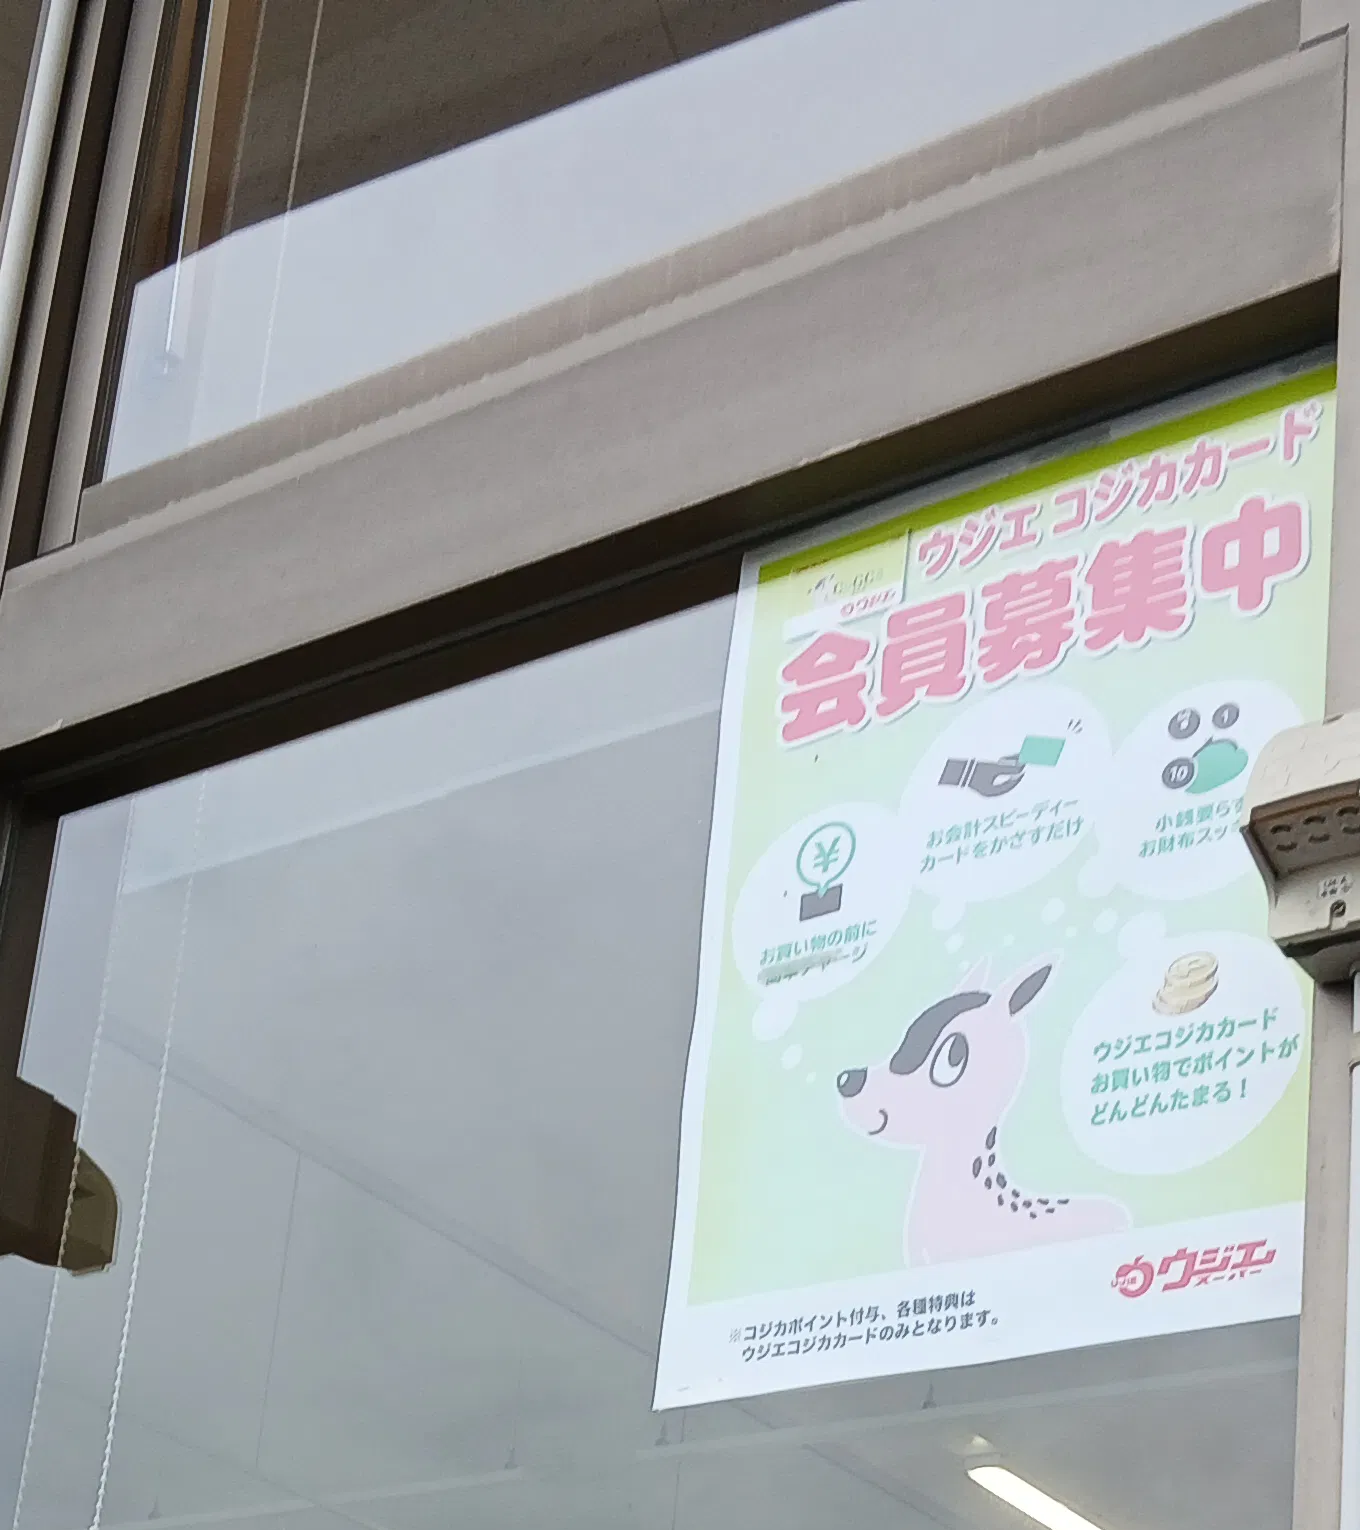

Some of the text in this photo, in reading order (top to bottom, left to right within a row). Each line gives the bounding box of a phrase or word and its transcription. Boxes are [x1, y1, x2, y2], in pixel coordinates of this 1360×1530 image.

[918, 402, 1321, 576] ウジエ コジカカード
[780, 496, 1306, 744] 会員募集中
[919, 815, 1085, 874] カードをかざすだけ
[926, 798, 1079, 849] お会計スピーディー
[760, 919, 877, 966] お買い物の前に
[1093, 1006, 1279, 1063] ウジエコジカカード
[1090, 1034, 1300, 1094] お買い物でポイントが
[1156, 1238, 1277, 1292] ウジエ
[741, 1309, 999, 1362] ウジエコジカカードのみとなります。
